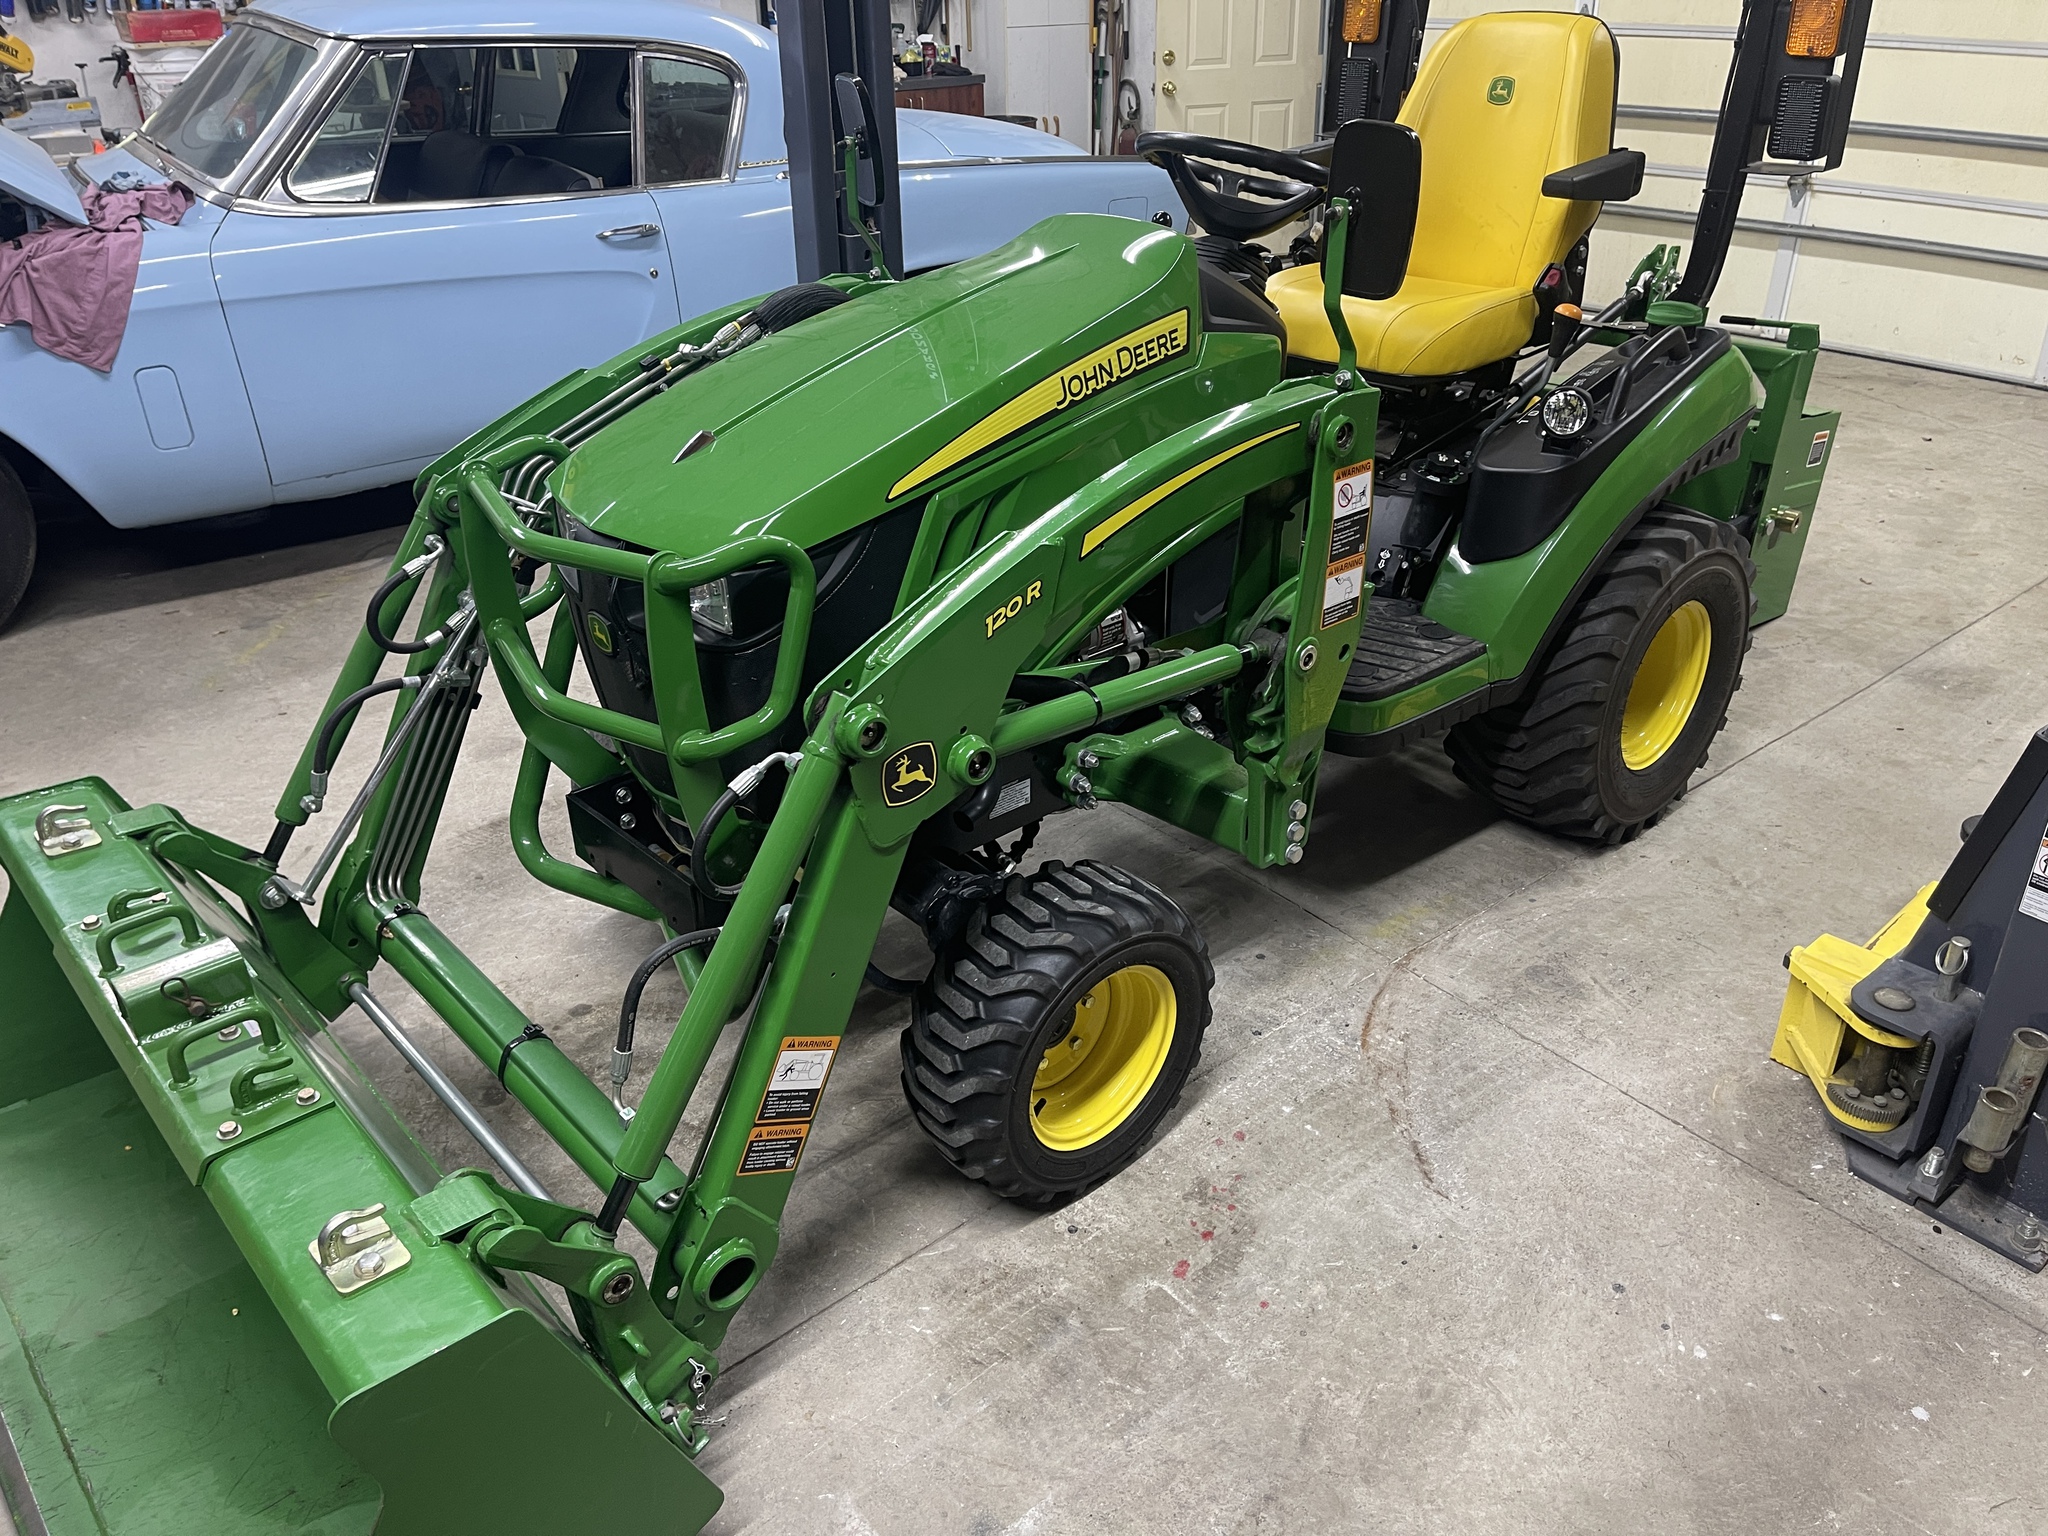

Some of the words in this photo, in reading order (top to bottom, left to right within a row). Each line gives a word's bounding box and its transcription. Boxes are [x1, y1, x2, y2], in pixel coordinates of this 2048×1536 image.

[1056, 358, 1115, 407] JOHN
[1116, 328, 1181, 374] DEERE
[1341, 462, 1371, 479] WARNING
[1334, 557, 1363, 575] WARNING
[985, 594, 1023, 639] 120
[1026, 580, 1042, 606] R
[797, 1040, 832, 1048] WARNING
[766, 1128, 802, 1137] WARNING
